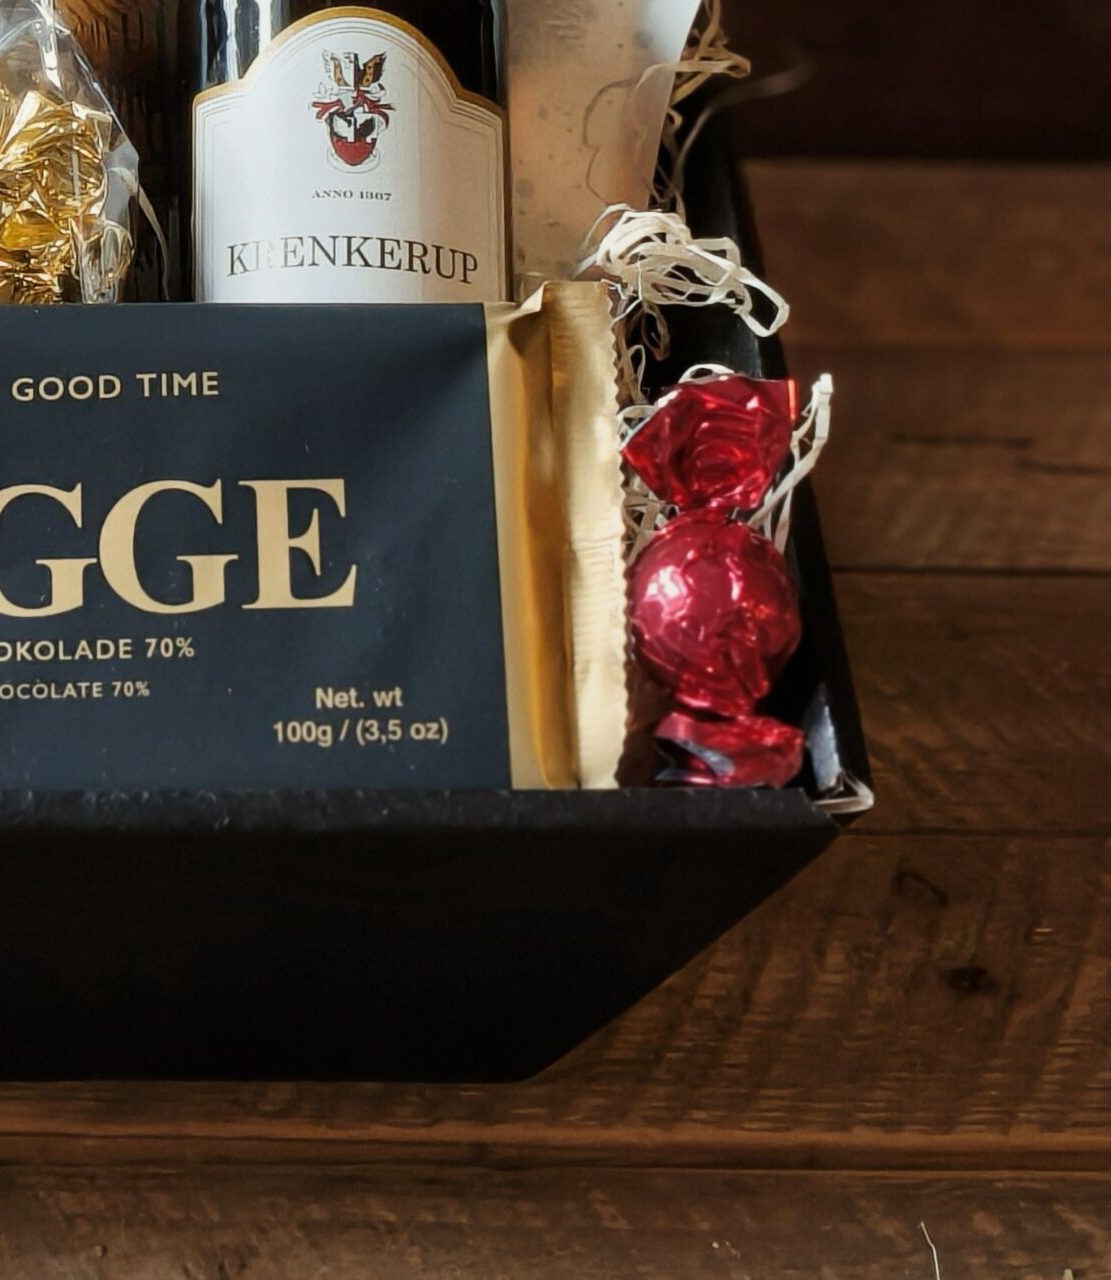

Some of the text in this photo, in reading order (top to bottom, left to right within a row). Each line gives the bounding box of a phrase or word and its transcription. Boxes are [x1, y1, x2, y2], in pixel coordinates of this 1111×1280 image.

[311, 189, 354, 199] ANNO
[226, 235, 479, 285] KRENKERUP
[11, 374, 122, 401] GOOD
[136, 371, 220, 397] TIME
[144, 636, 195, 660] 70%
[111, 680, 150, 698] 70%
[315, 686, 404, 709] Net. wt
[273, 717, 449, 748] 100g / (3,5 oz)
